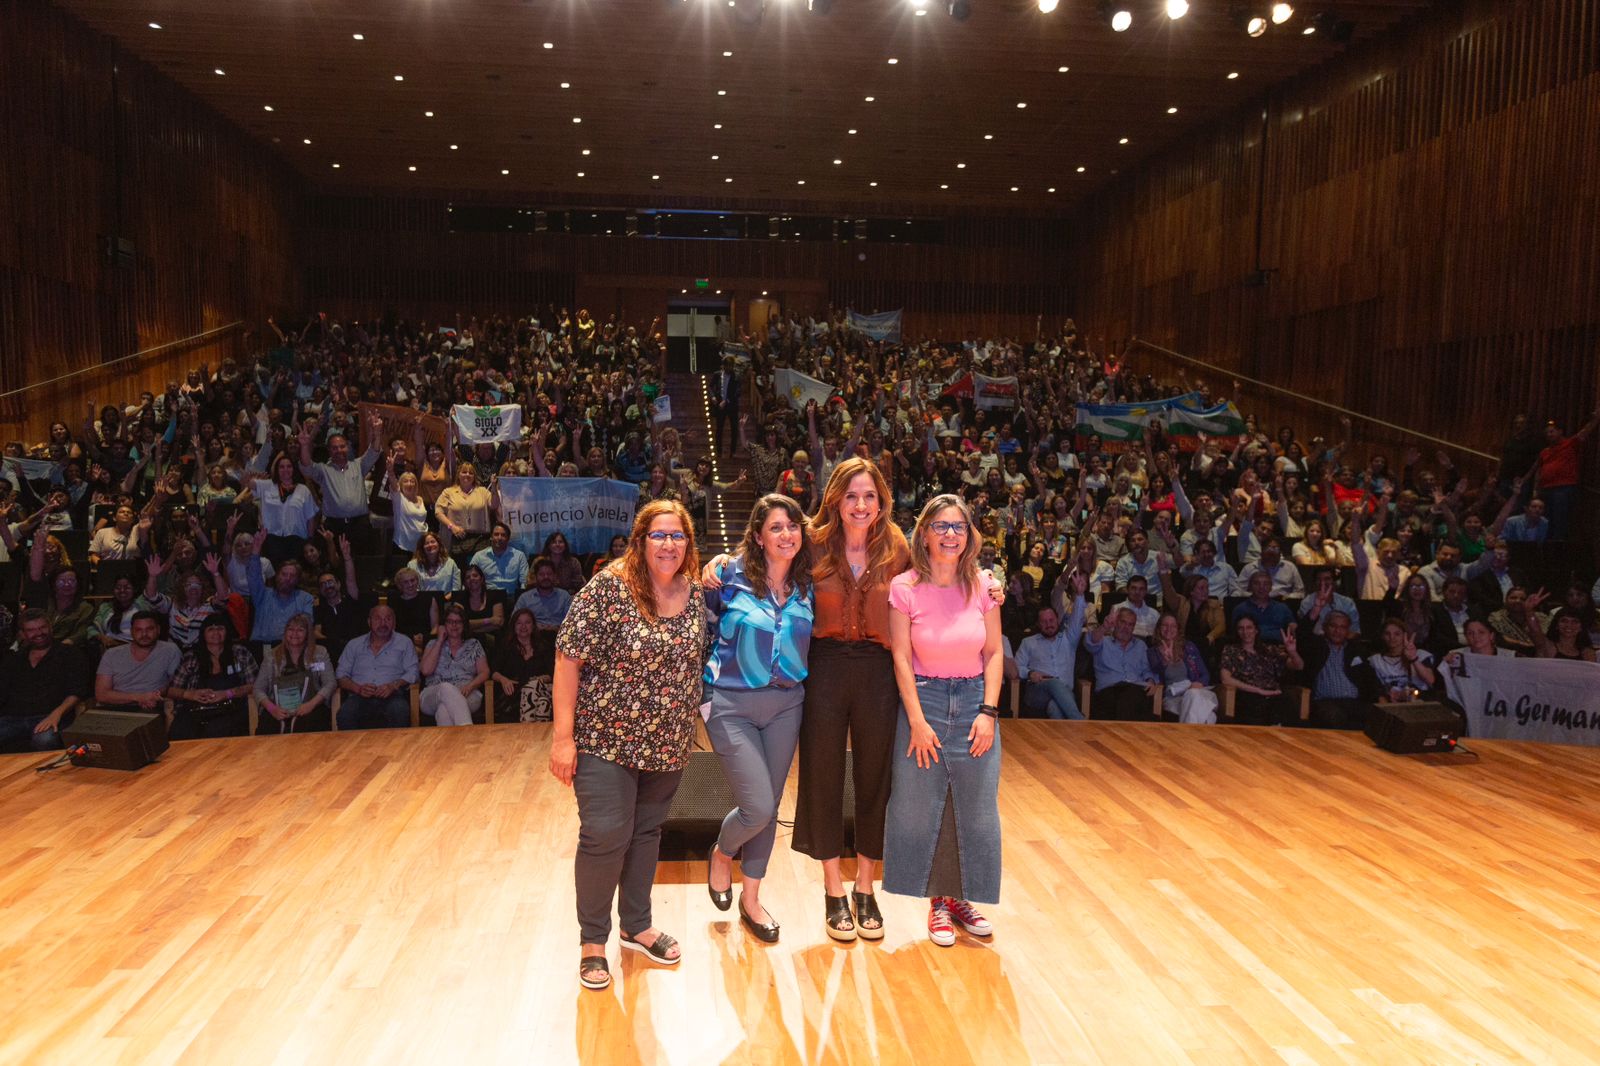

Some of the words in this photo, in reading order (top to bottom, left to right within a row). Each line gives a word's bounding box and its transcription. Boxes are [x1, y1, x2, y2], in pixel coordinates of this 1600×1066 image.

[475, 417, 502, 427] SIGLO
[481, 427, 498, 437] XX
[508, 507, 584, 525] Florencio
[587, 504, 628, 523] Varela
[1484, 691, 1507, 717] La
